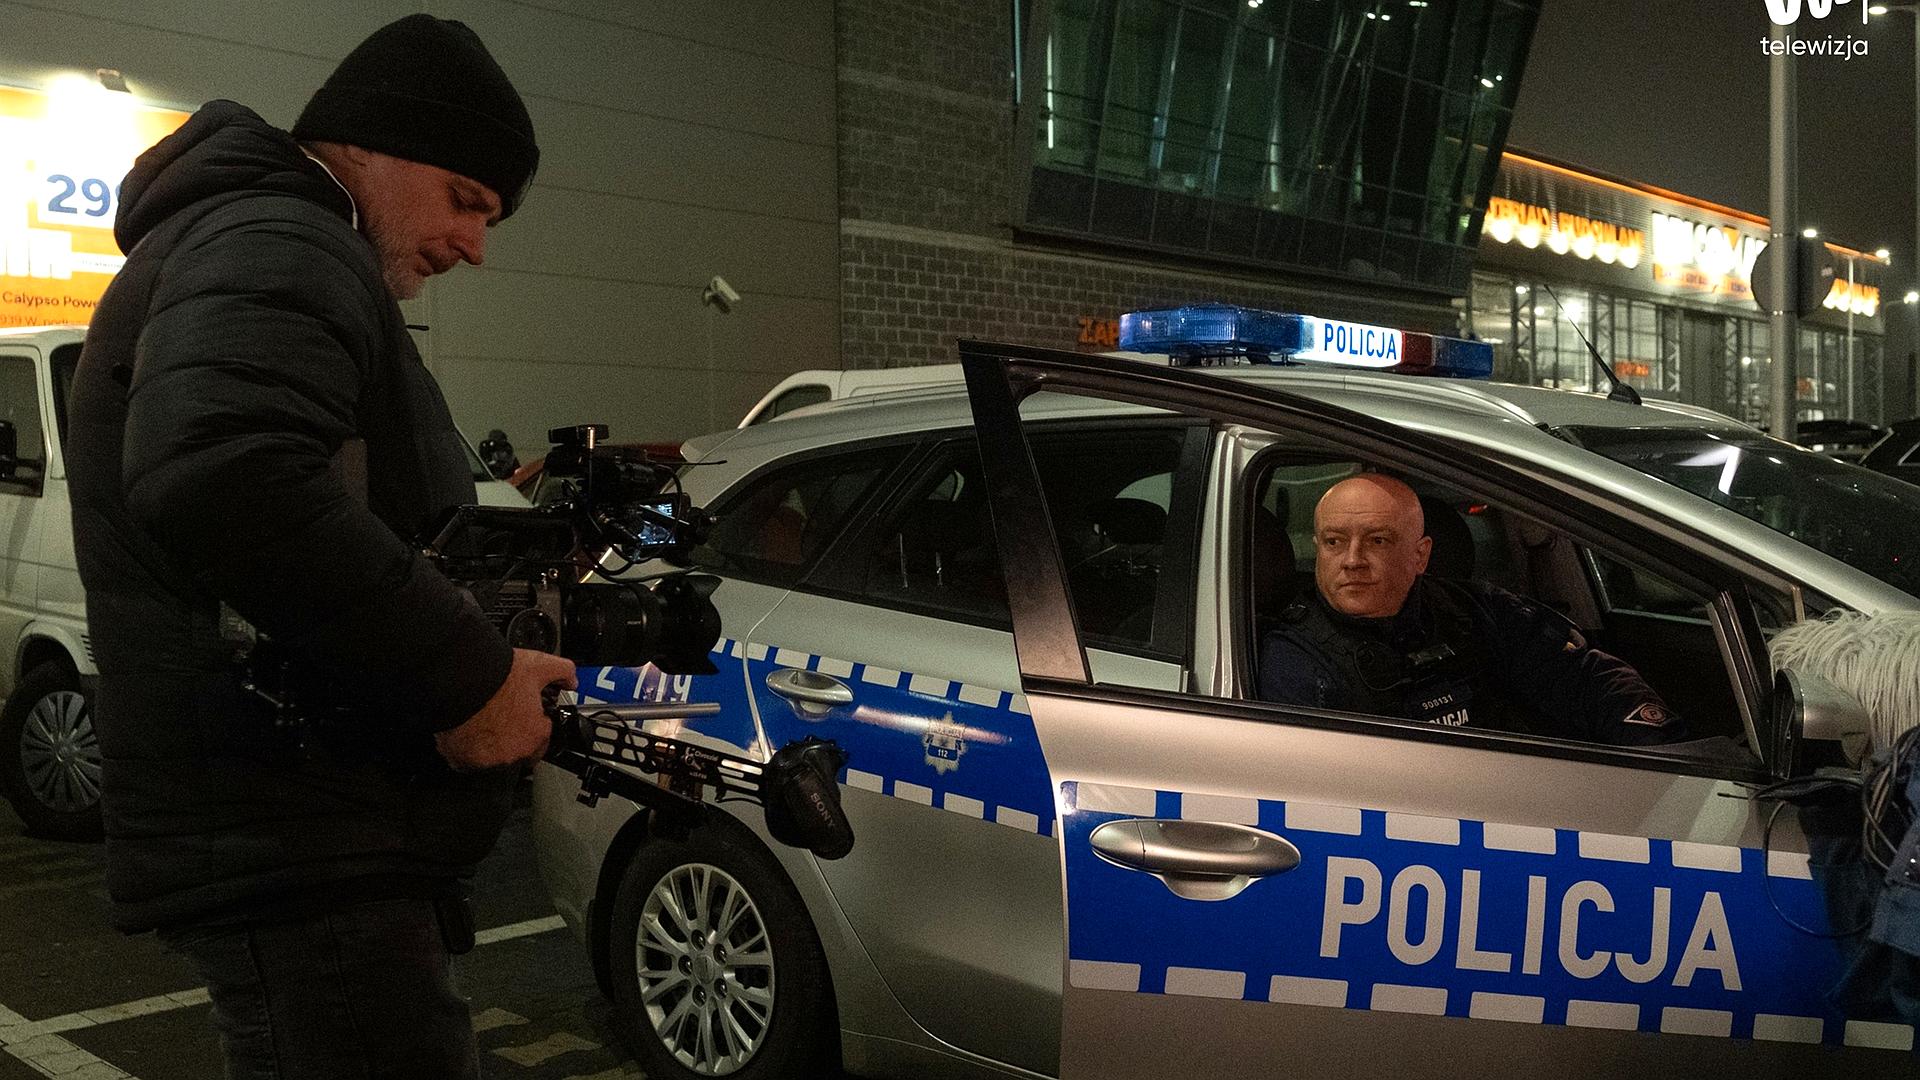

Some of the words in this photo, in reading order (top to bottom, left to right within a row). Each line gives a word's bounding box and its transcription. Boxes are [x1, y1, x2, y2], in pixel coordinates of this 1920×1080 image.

[47, 173, 121, 217] 29
[2, 291, 60, 309] Calypso
[1324, 323, 1397, 360] POLICJA
[1422, 694, 1454, 710] 908131
[938, 748, 949, 758] 112
[810, 792, 836, 829] SONY
[1319, 855, 1743, 991] POLICJA
